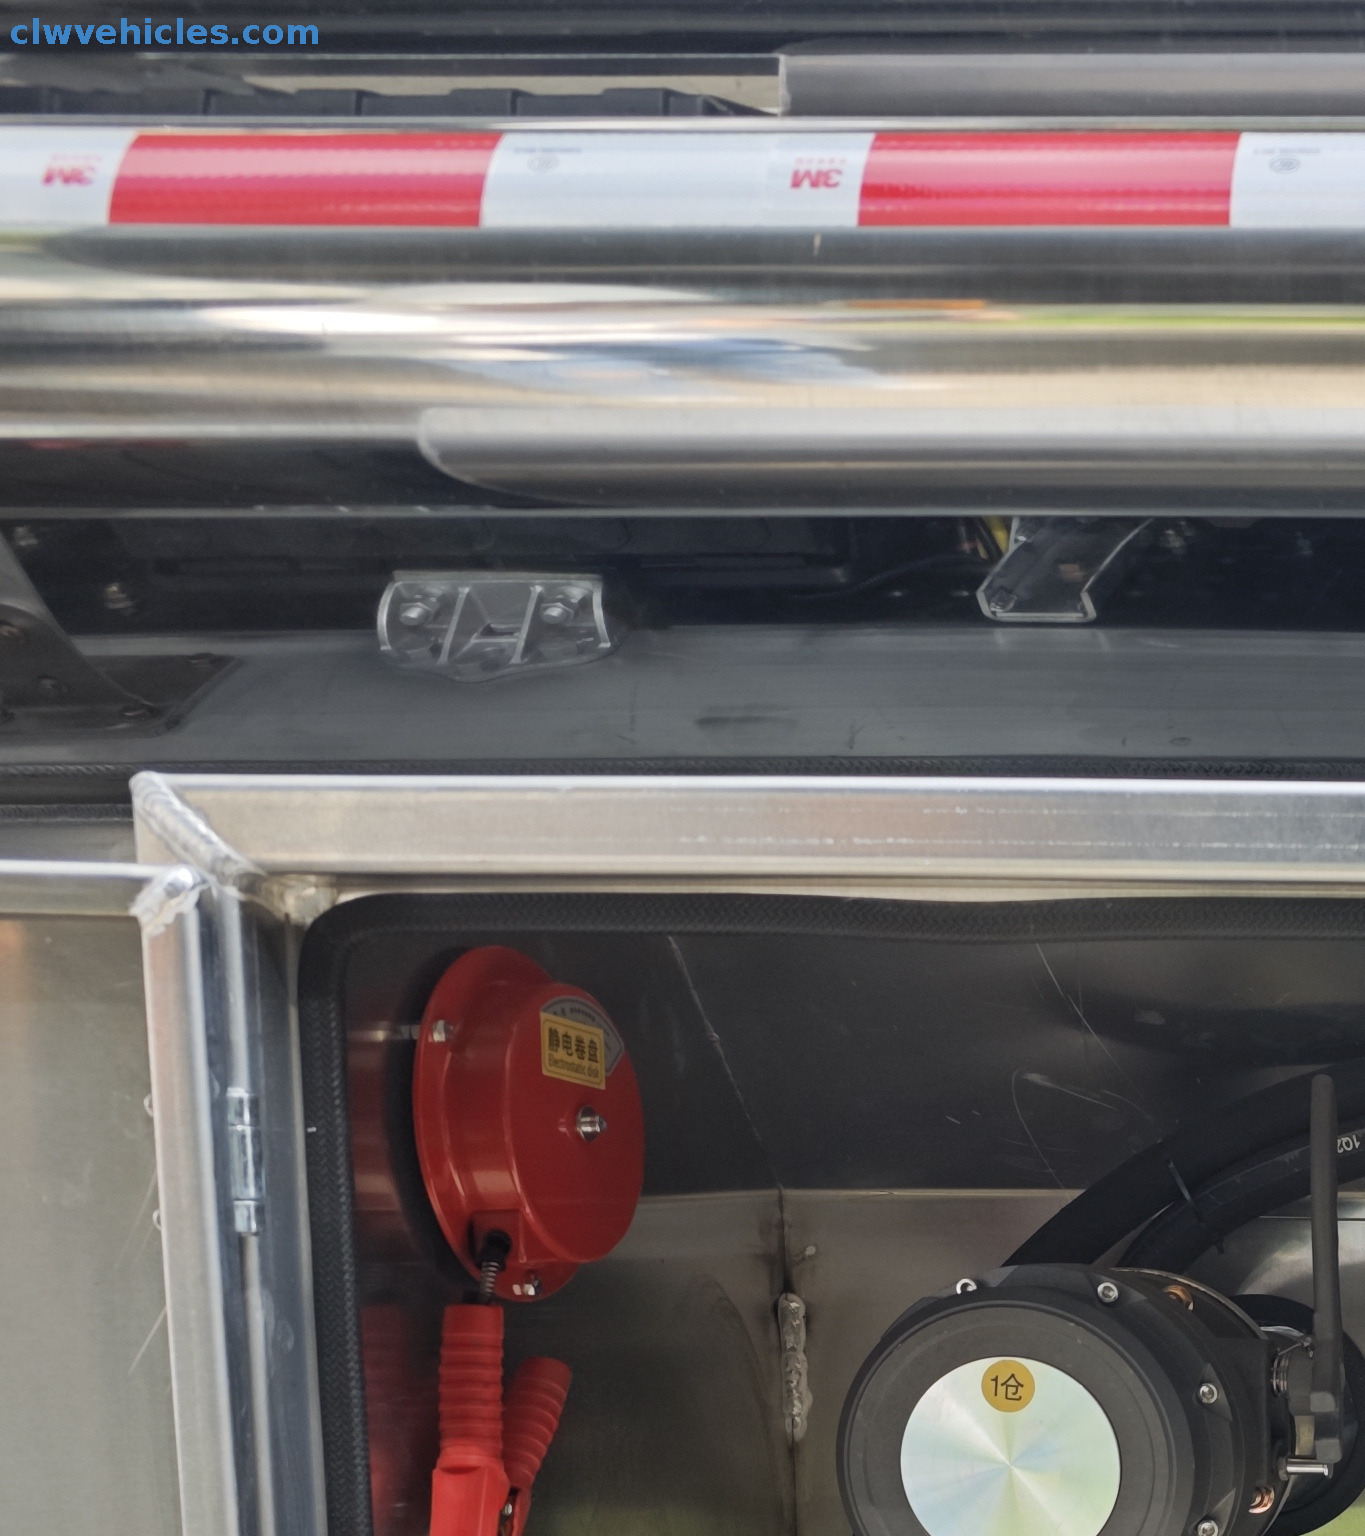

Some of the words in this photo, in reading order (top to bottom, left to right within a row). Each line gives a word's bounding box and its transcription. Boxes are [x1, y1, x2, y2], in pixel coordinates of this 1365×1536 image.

[789, 168, 843, 189] 3M
[1337, 1134, 1360, 1153] 1Q2
[991, 1372, 1025, 1401] 1仓
